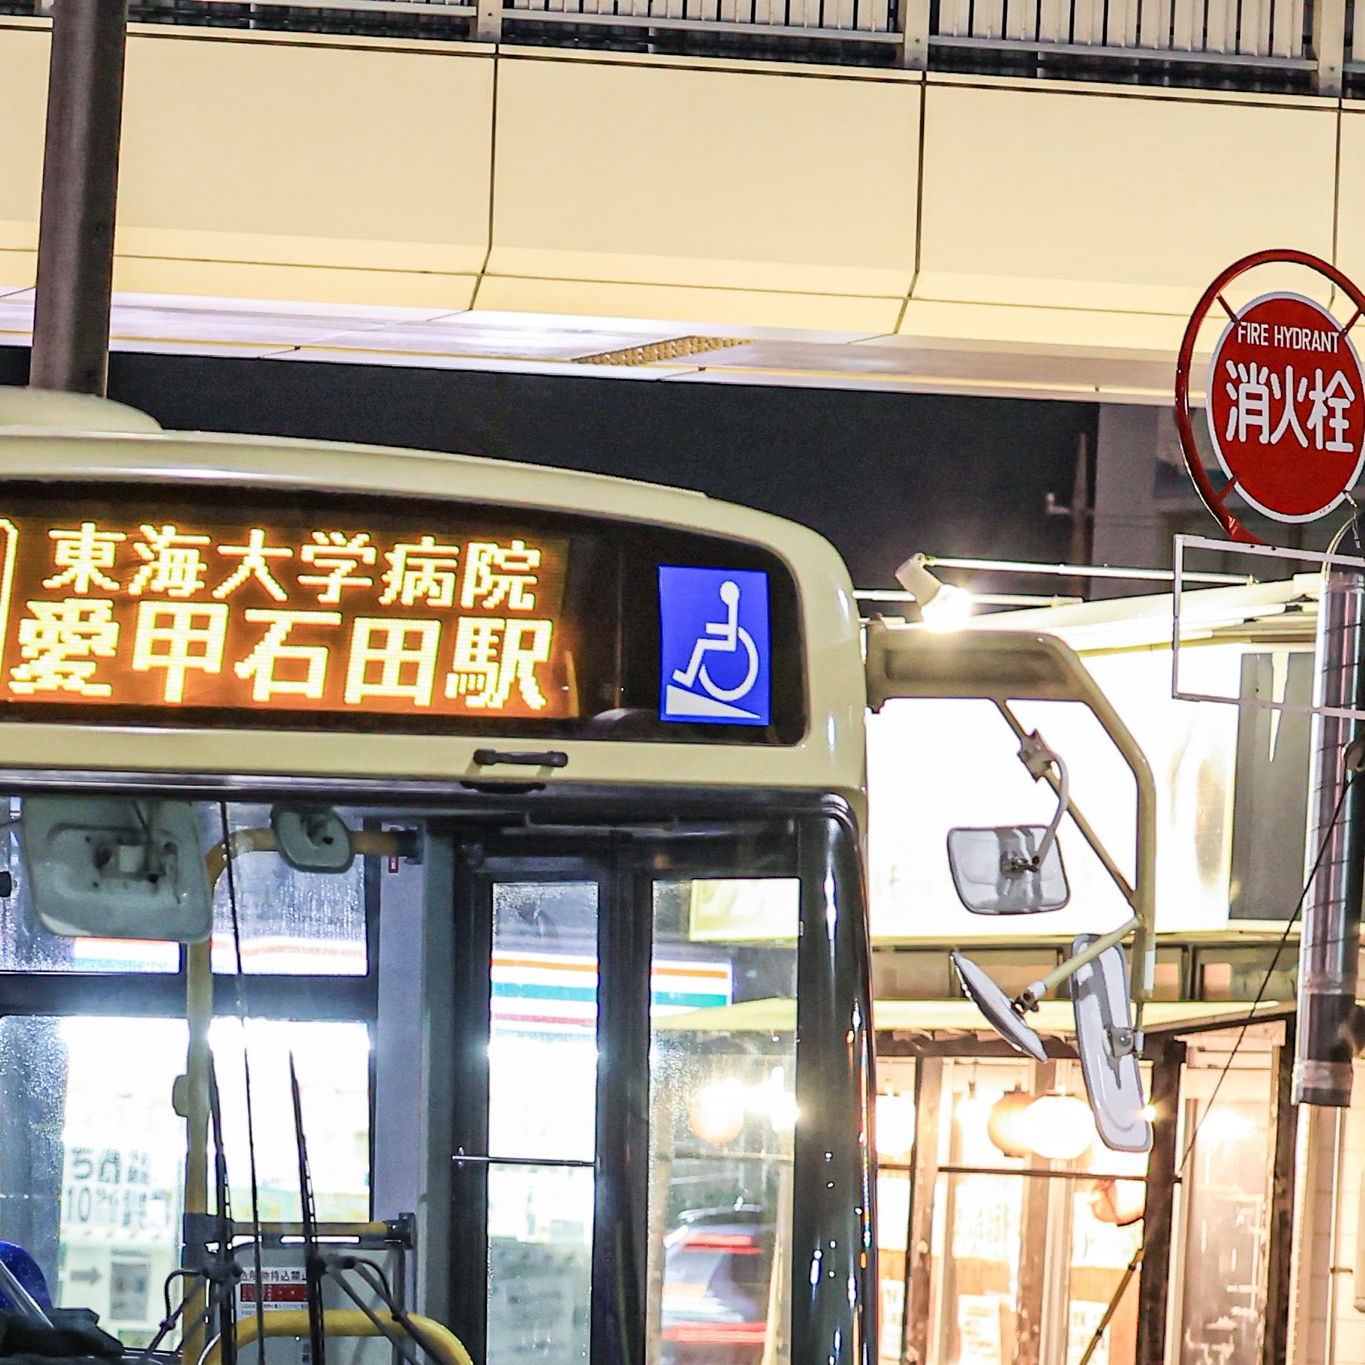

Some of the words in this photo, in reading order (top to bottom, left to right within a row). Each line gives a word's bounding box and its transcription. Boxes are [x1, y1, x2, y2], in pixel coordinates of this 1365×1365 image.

[1236, 321, 1270, 347] FIRE
[1273, 324, 1340, 355] HYDRANT
[1225, 358, 1356, 453] 消火栓
[41, 521, 542, 609] 東海大学病院
[9, 597, 554, 709] 愛甲石田駅
